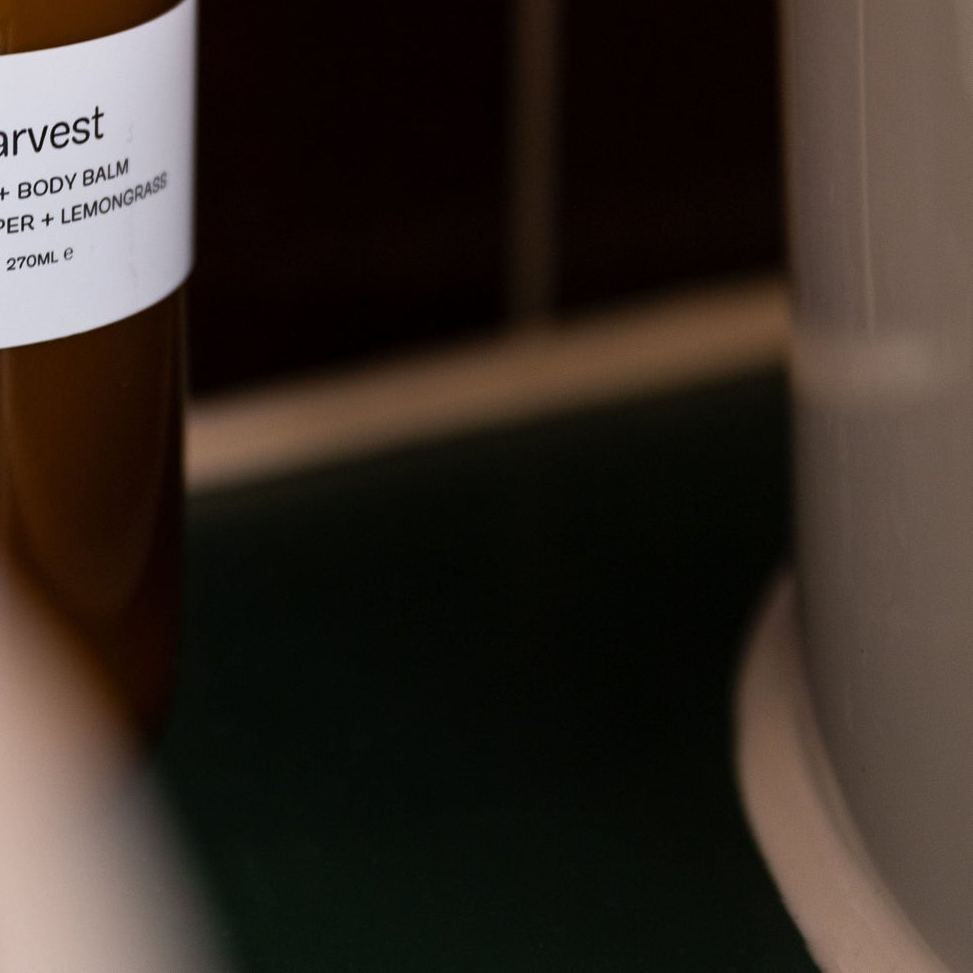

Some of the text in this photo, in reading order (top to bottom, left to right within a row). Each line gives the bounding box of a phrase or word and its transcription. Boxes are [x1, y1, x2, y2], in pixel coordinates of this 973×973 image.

[17, 172, 77, 200] BODY
[82, 158, 129, 187] BALM
[41, 213, 55, 226] +
[61, 171, 168, 225] LEMONGRASS
[6, 250, 59, 271] 270ML
